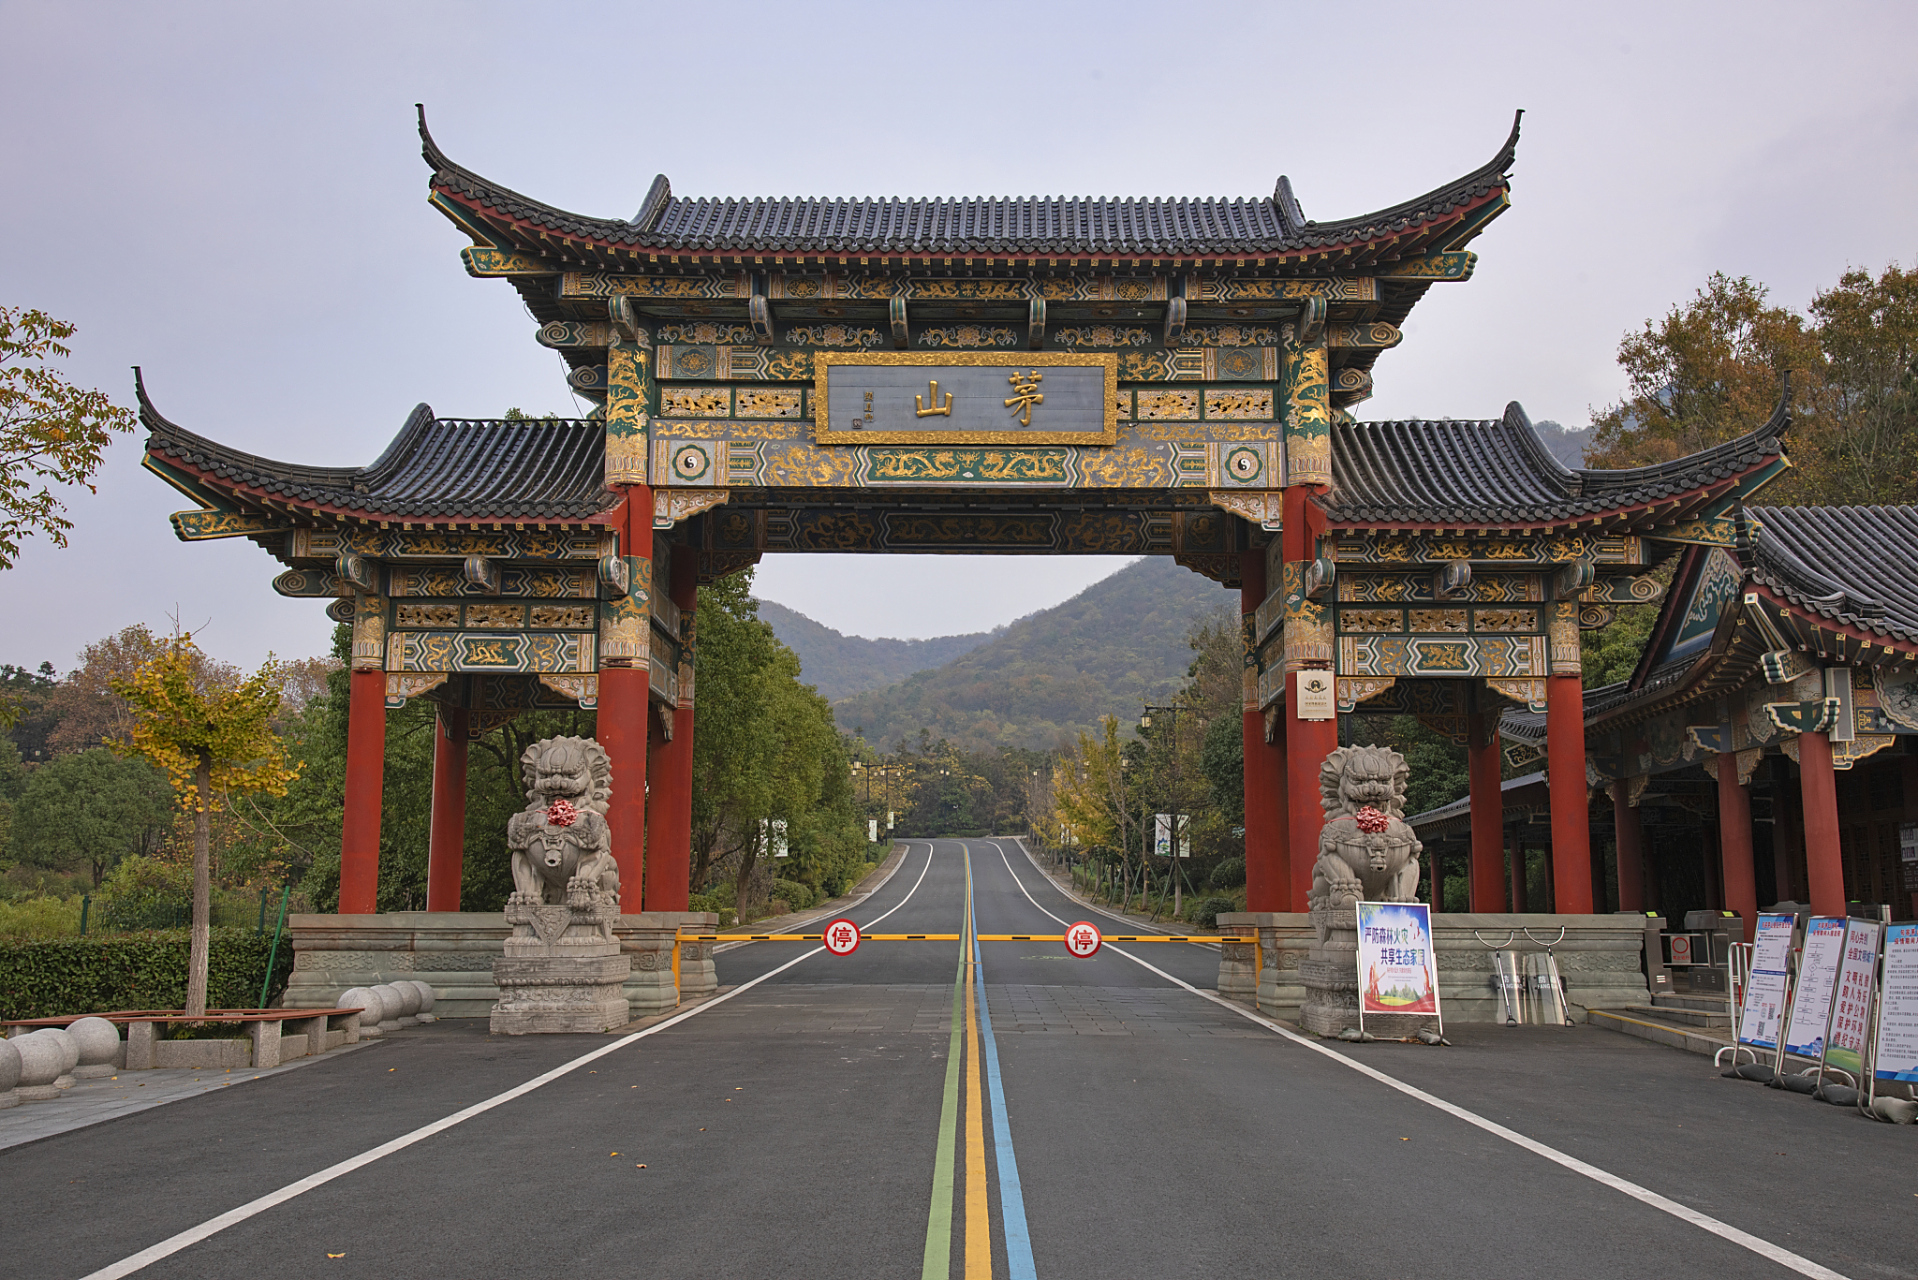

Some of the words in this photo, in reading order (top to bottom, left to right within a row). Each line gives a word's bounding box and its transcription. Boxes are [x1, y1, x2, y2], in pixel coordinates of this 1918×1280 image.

[831, 926, 853, 948] 停
[1072, 929, 1094, 951] 停
[1364, 926, 1409, 945] 严防森林火灾
[1849, 930, 1869, 945] 同心共创
[1380, 948, 1425, 966] 共享生态家园
[1842, 985, 1868, 1003] 助人为乐
[1839, 1000, 1866, 1020] 爱护公物
[1836, 1015, 1864, 1036] 保护环境
[1834, 1031, 1861, 1051] 遵纪守法
